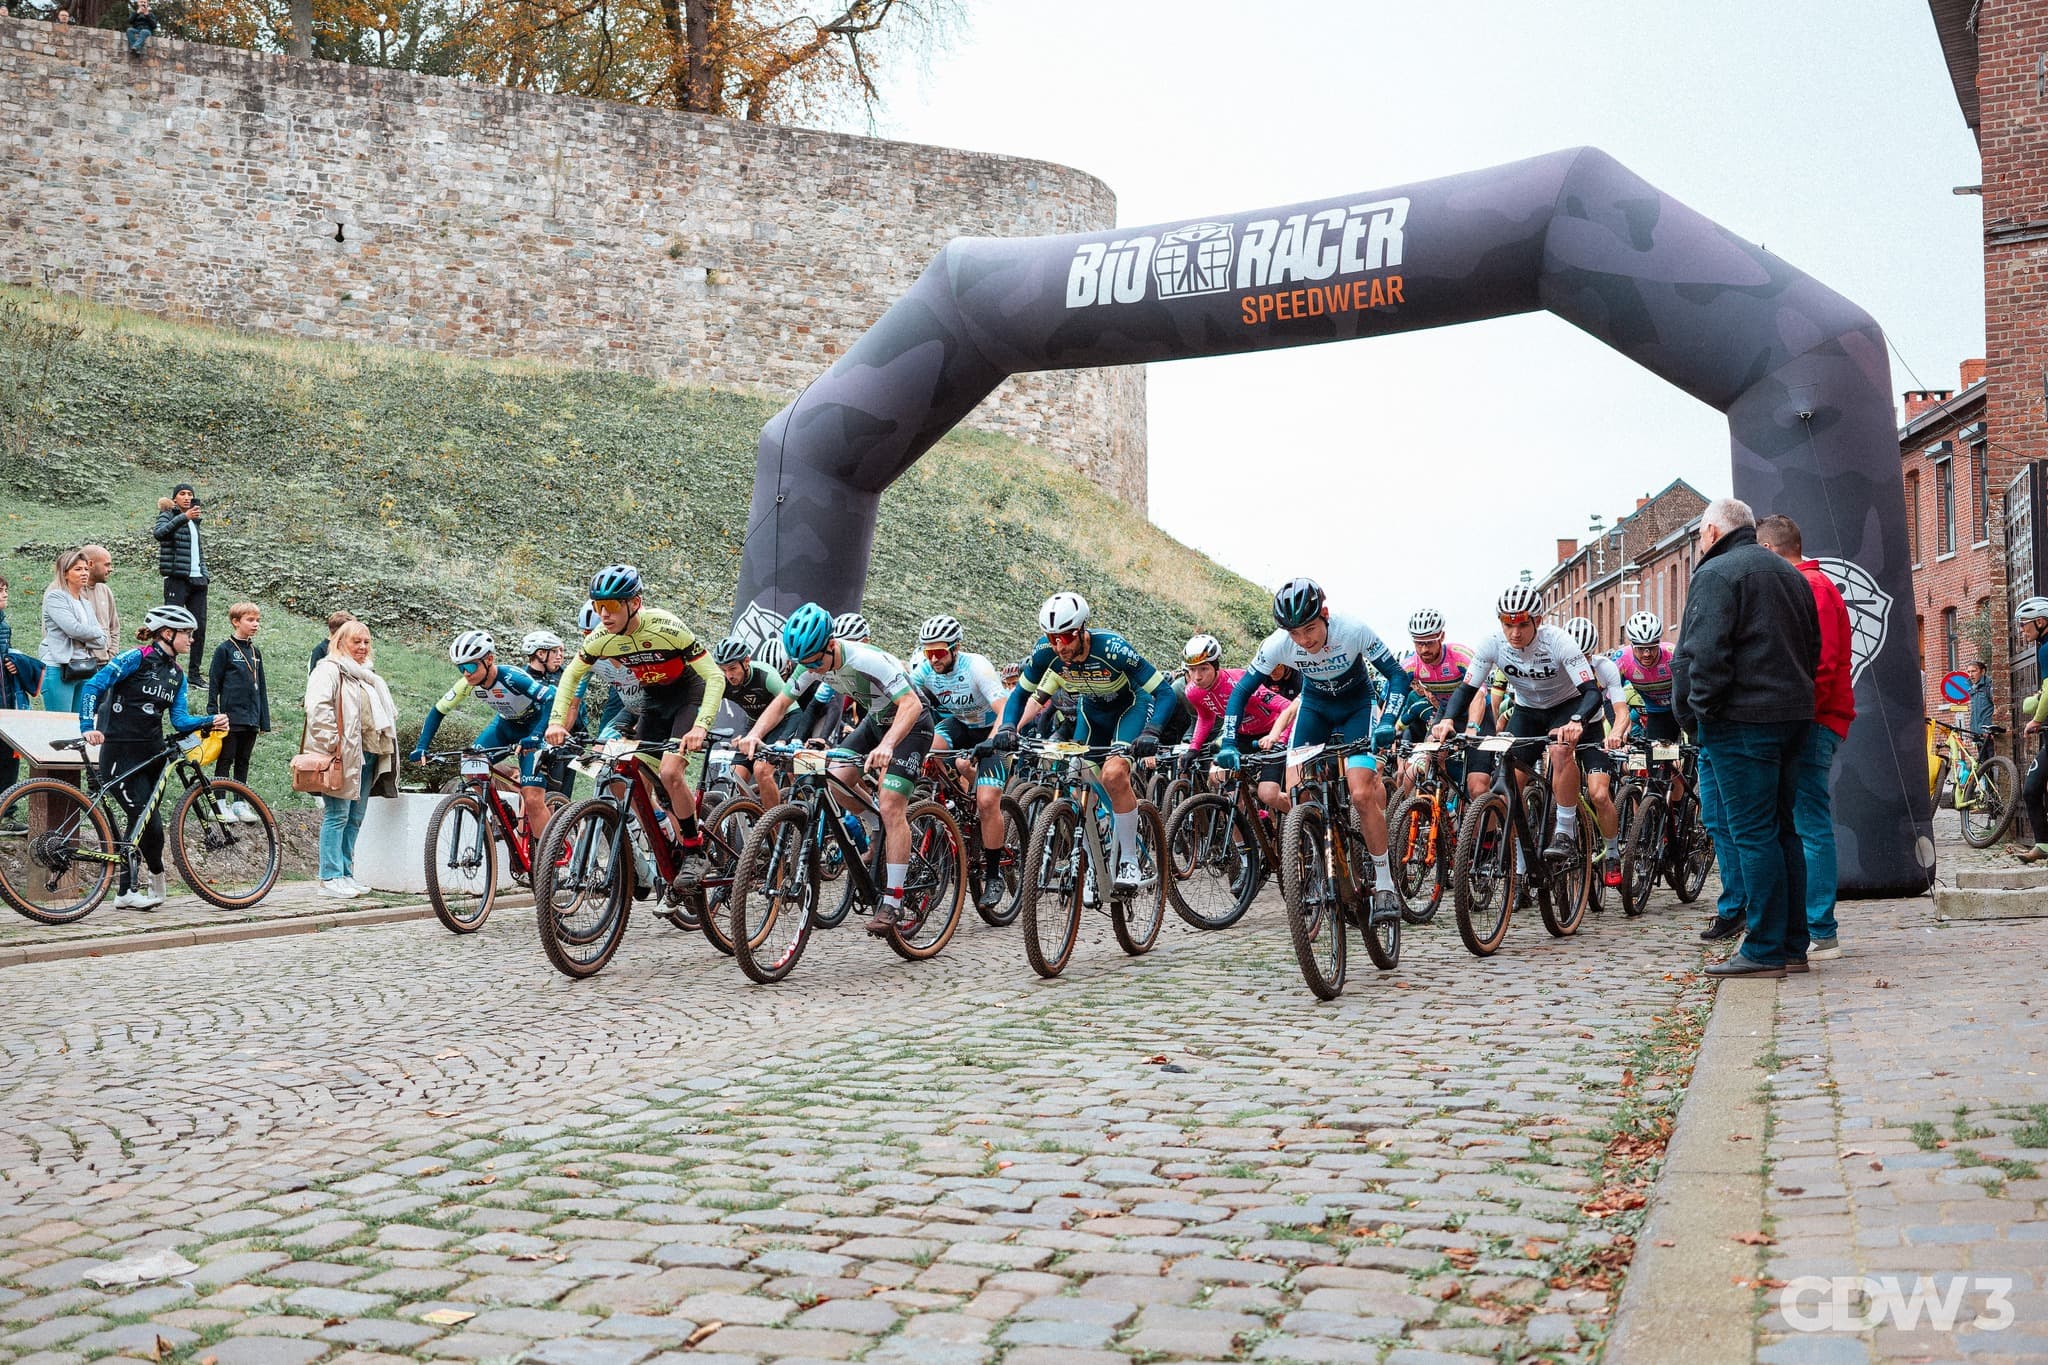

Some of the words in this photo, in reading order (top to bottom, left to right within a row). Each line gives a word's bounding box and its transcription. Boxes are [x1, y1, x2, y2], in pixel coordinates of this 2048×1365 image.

[1066, 236, 1156, 309] BIO
[1236, 197, 1411, 289] RACER
[1241, 275, 1406, 326] SPEEDWEAR
[1503, 664, 1557, 679] Quick
